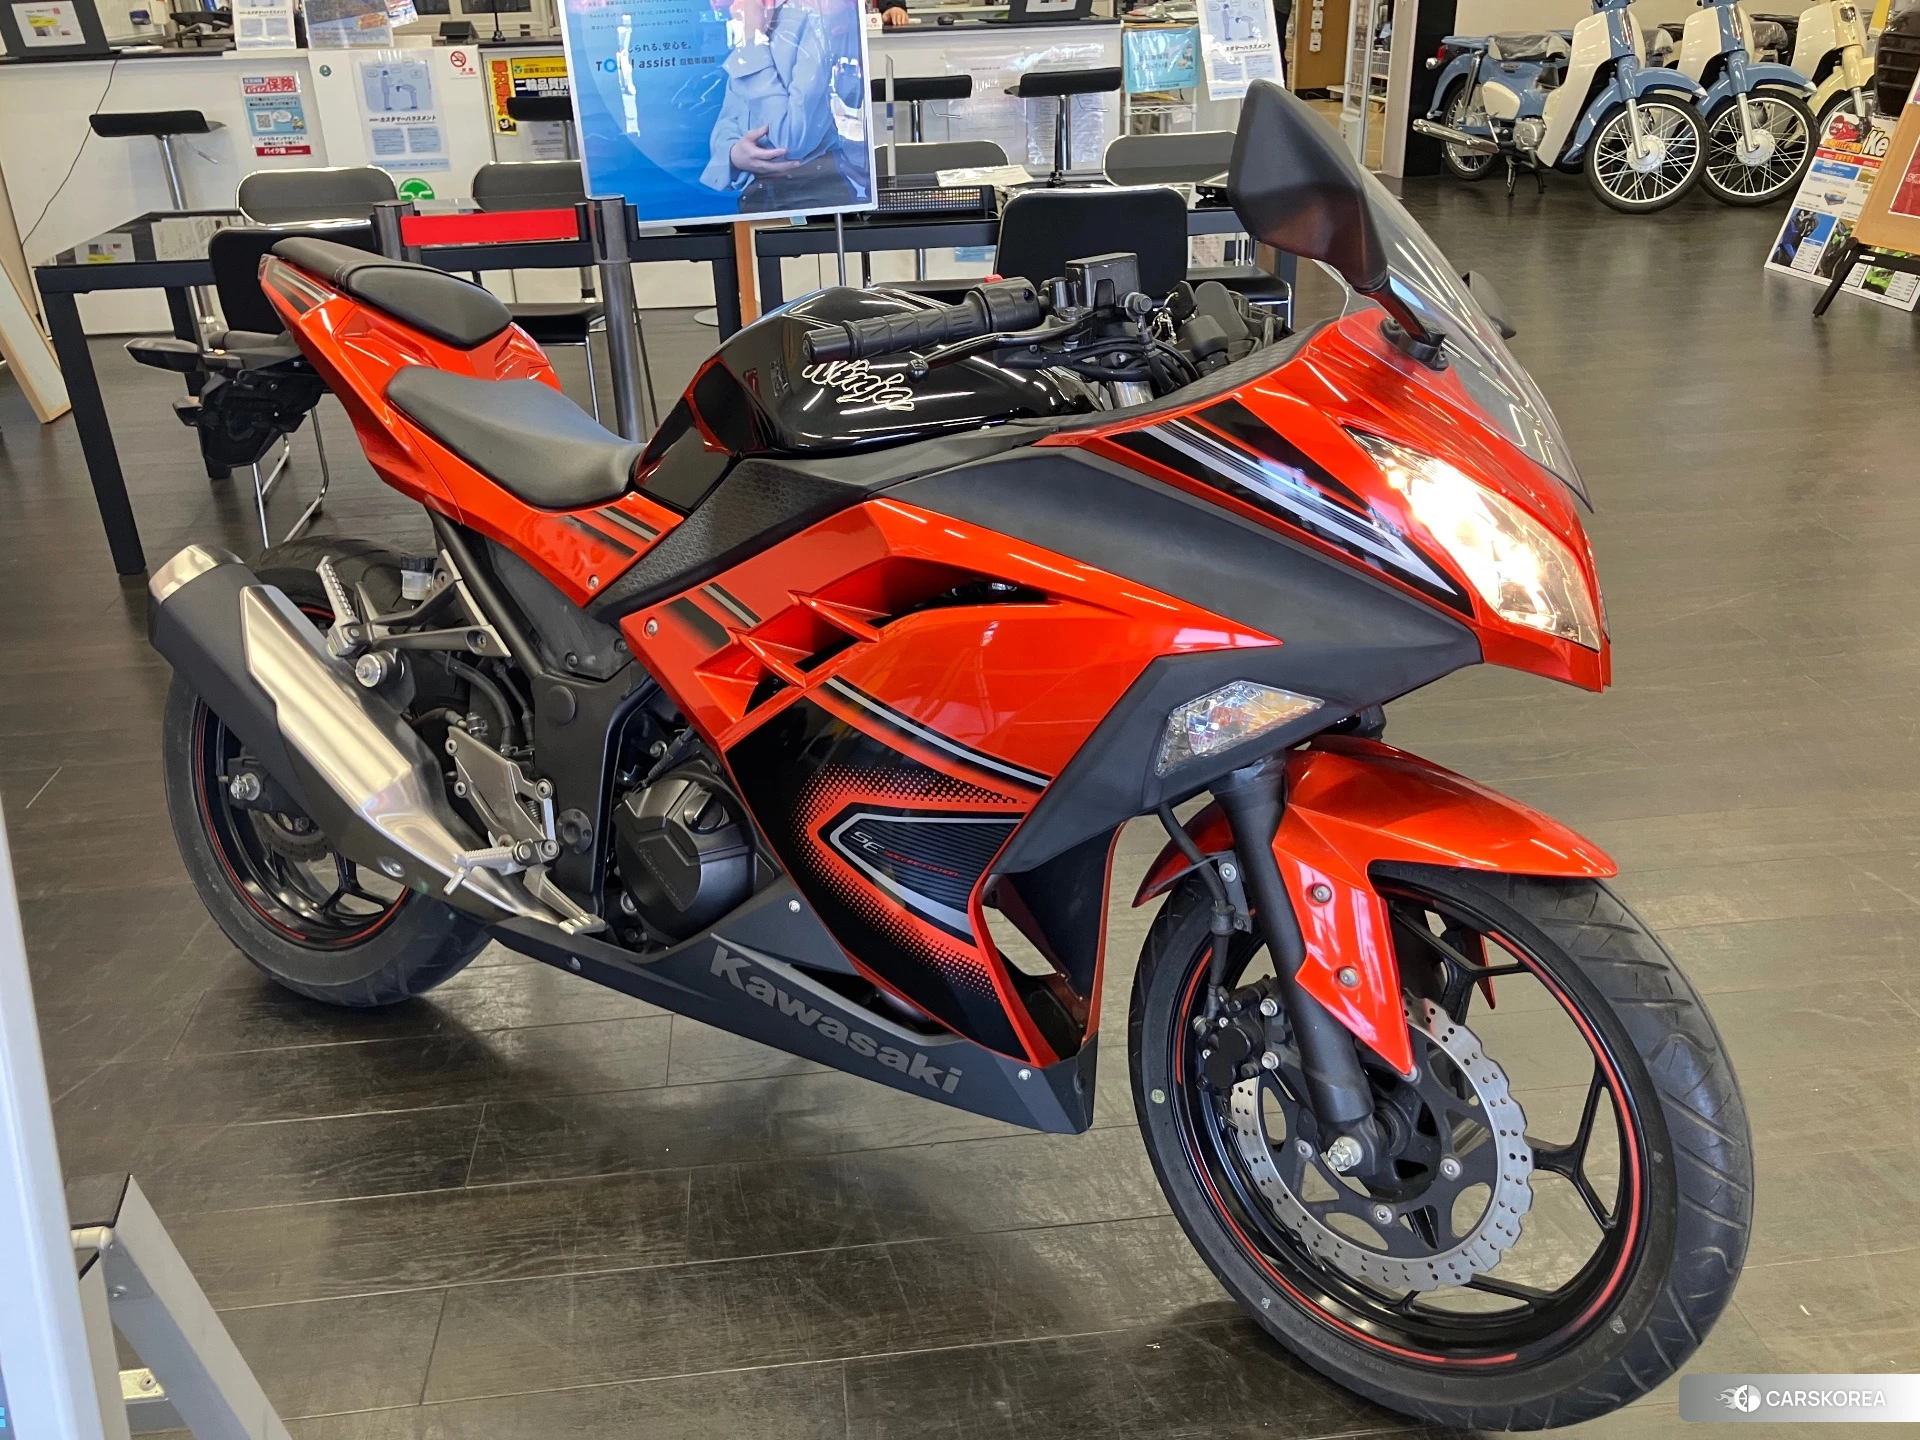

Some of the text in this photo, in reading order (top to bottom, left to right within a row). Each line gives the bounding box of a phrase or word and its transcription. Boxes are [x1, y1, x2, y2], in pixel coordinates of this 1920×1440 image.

[639, 56, 676, 69] assist
[850, 831, 885, 854] SE
[709, 945, 963, 1094] Kawasaki
